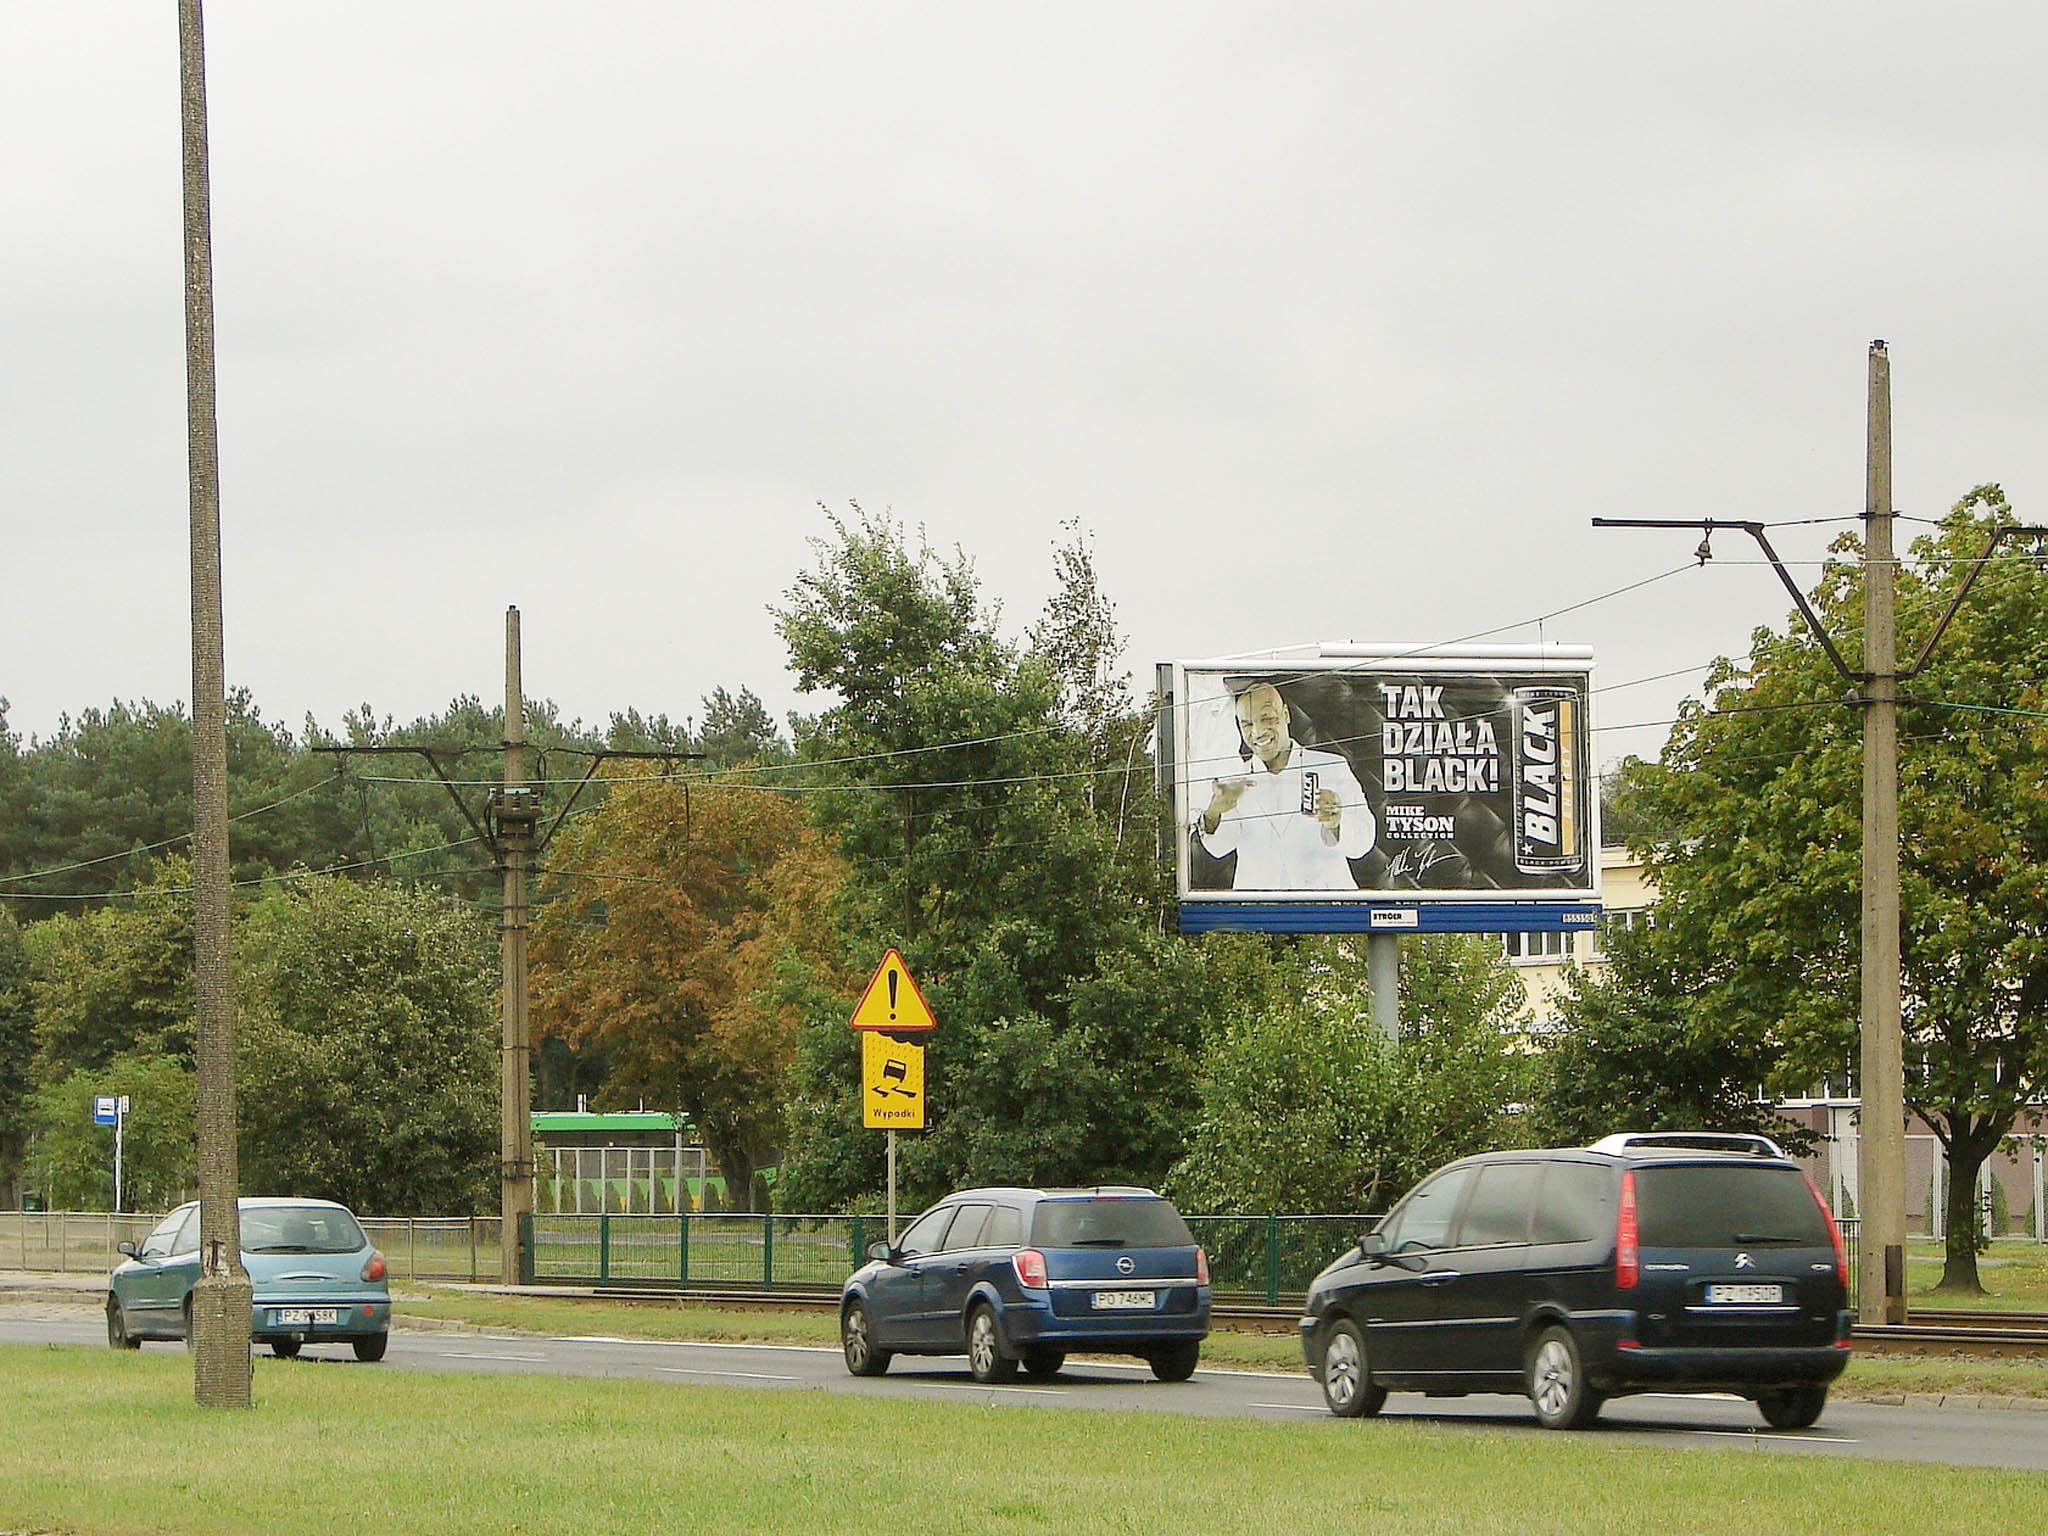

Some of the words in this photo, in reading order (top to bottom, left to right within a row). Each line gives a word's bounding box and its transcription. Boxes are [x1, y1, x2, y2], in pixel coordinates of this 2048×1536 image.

[1381, 685, 1444, 718] TAK
[1382, 720, 1499, 755] DZIAŁA
[1382, 758, 1499, 792] BLACK!
[1523, 705, 1557, 845] BLACK
[1384, 805, 1425, 817] MIKE
[1384, 816, 1455, 833] TYSON
[872, 1109, 915, 1120] Wypadki
[284, 1310, 299, 1321] PZ
[302, 1310, 335, 1321] 958K
